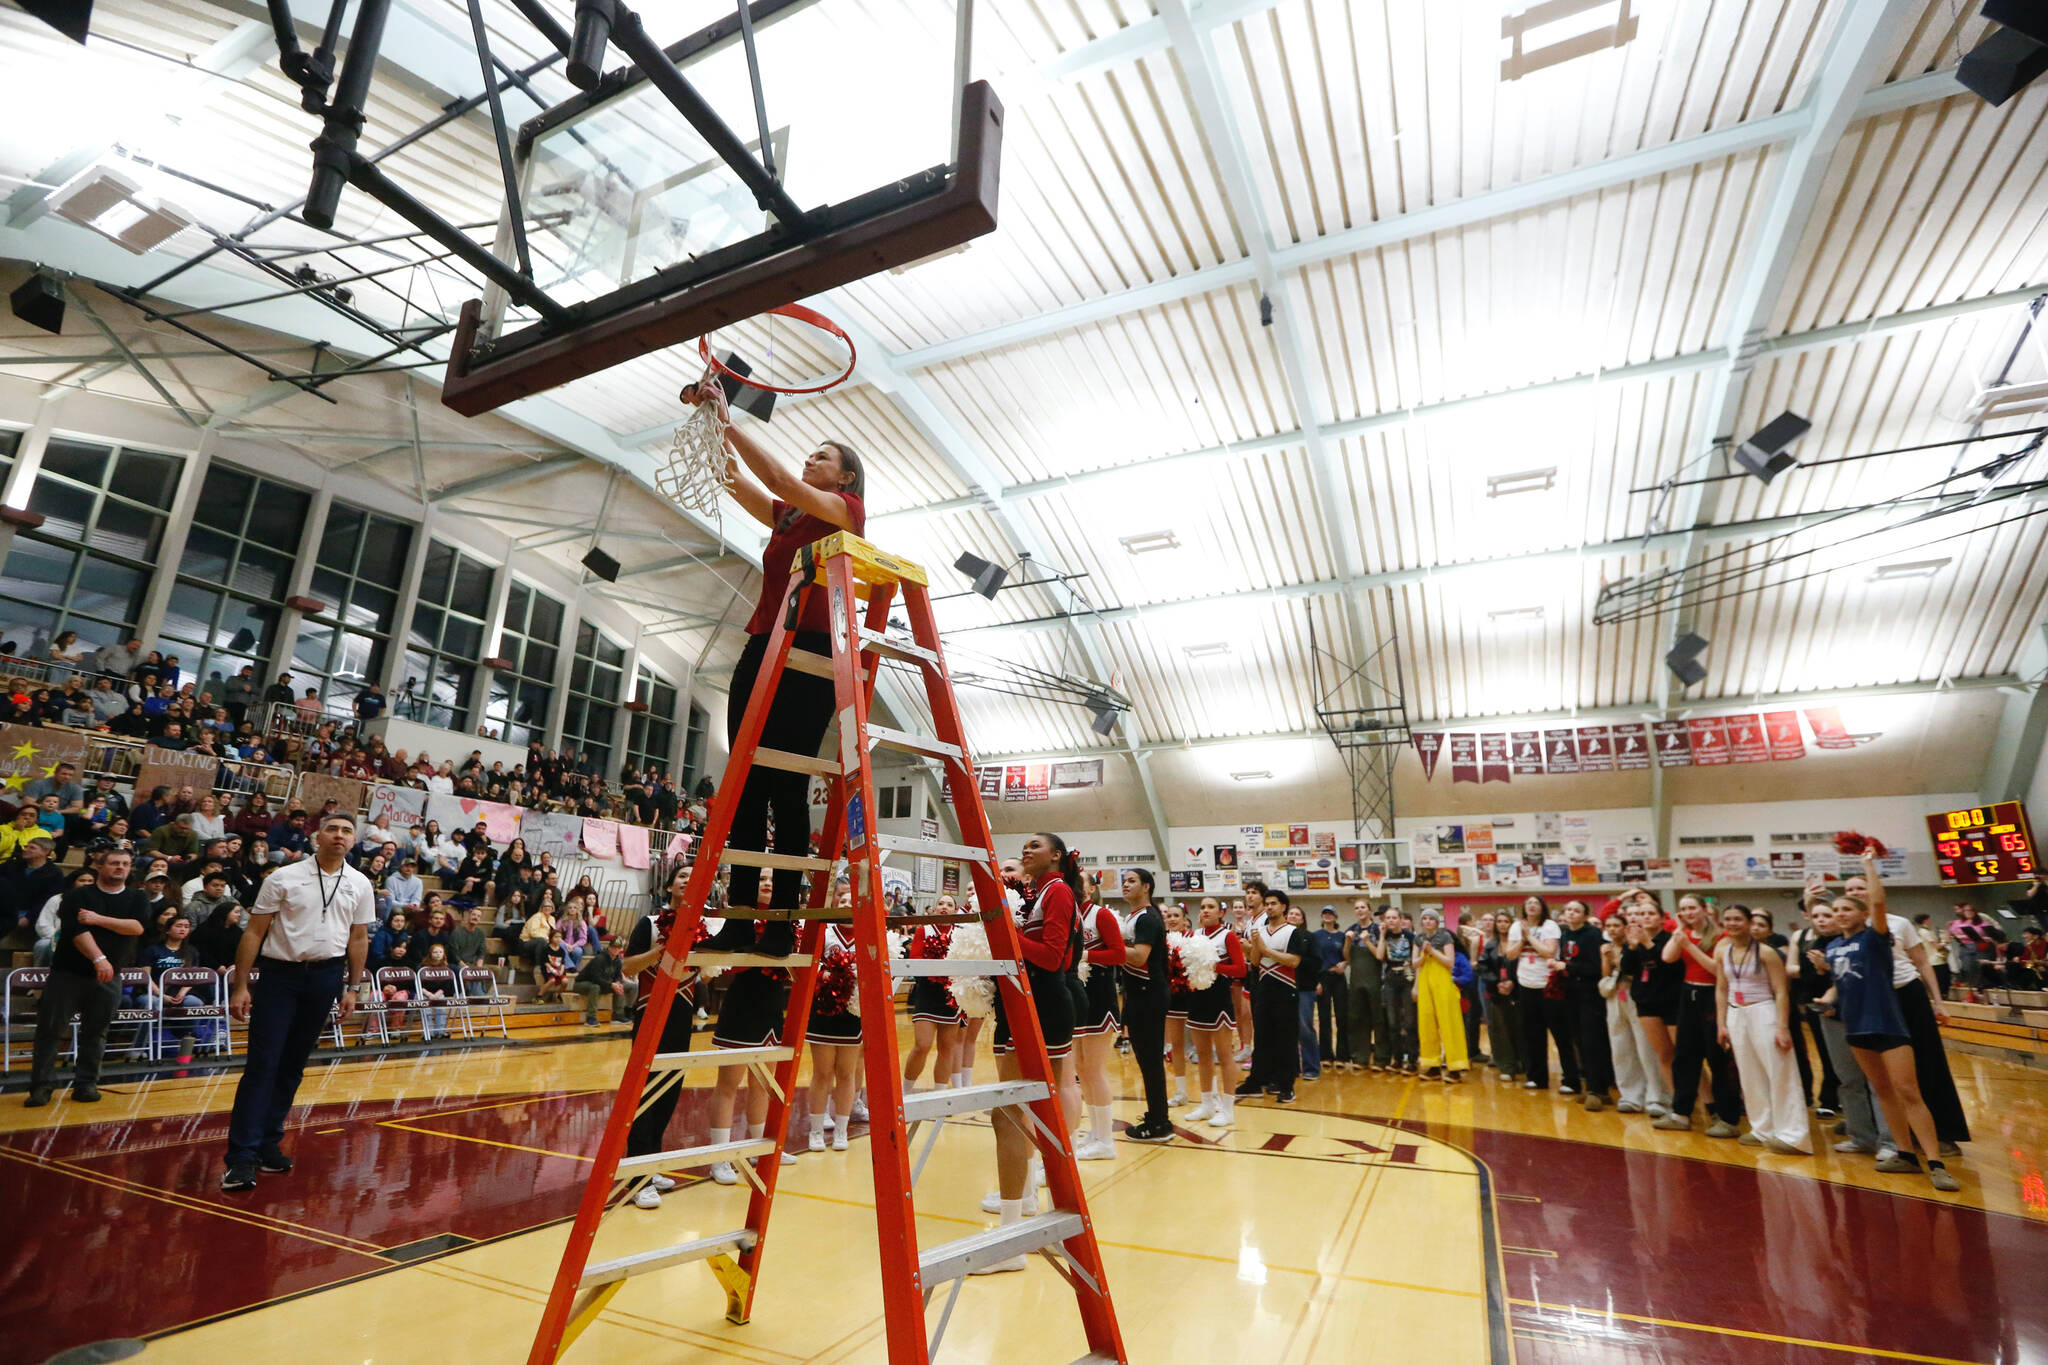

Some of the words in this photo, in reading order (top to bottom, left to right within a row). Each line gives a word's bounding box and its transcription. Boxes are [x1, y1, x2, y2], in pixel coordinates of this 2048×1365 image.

[148, 746, 217, 771] LOOKING
[375, 785, 396, 802] Go
[812, 787, 830, 805] 23
[381, 804, 422, 826] Maroon
[2000, 833, 2026, 851] 65
[20, 972, 49, 982] KAY
[120, 972, 144, 981] YHI
[171, 972, 209, 980] KAYHI
[384, 970, 411, 978] KAYHI
[407, 1000, 430, 1008] KINGS
[118, 1011, 153, 1020] KINGS
[186, 1008, 221, 1016] KINGS
